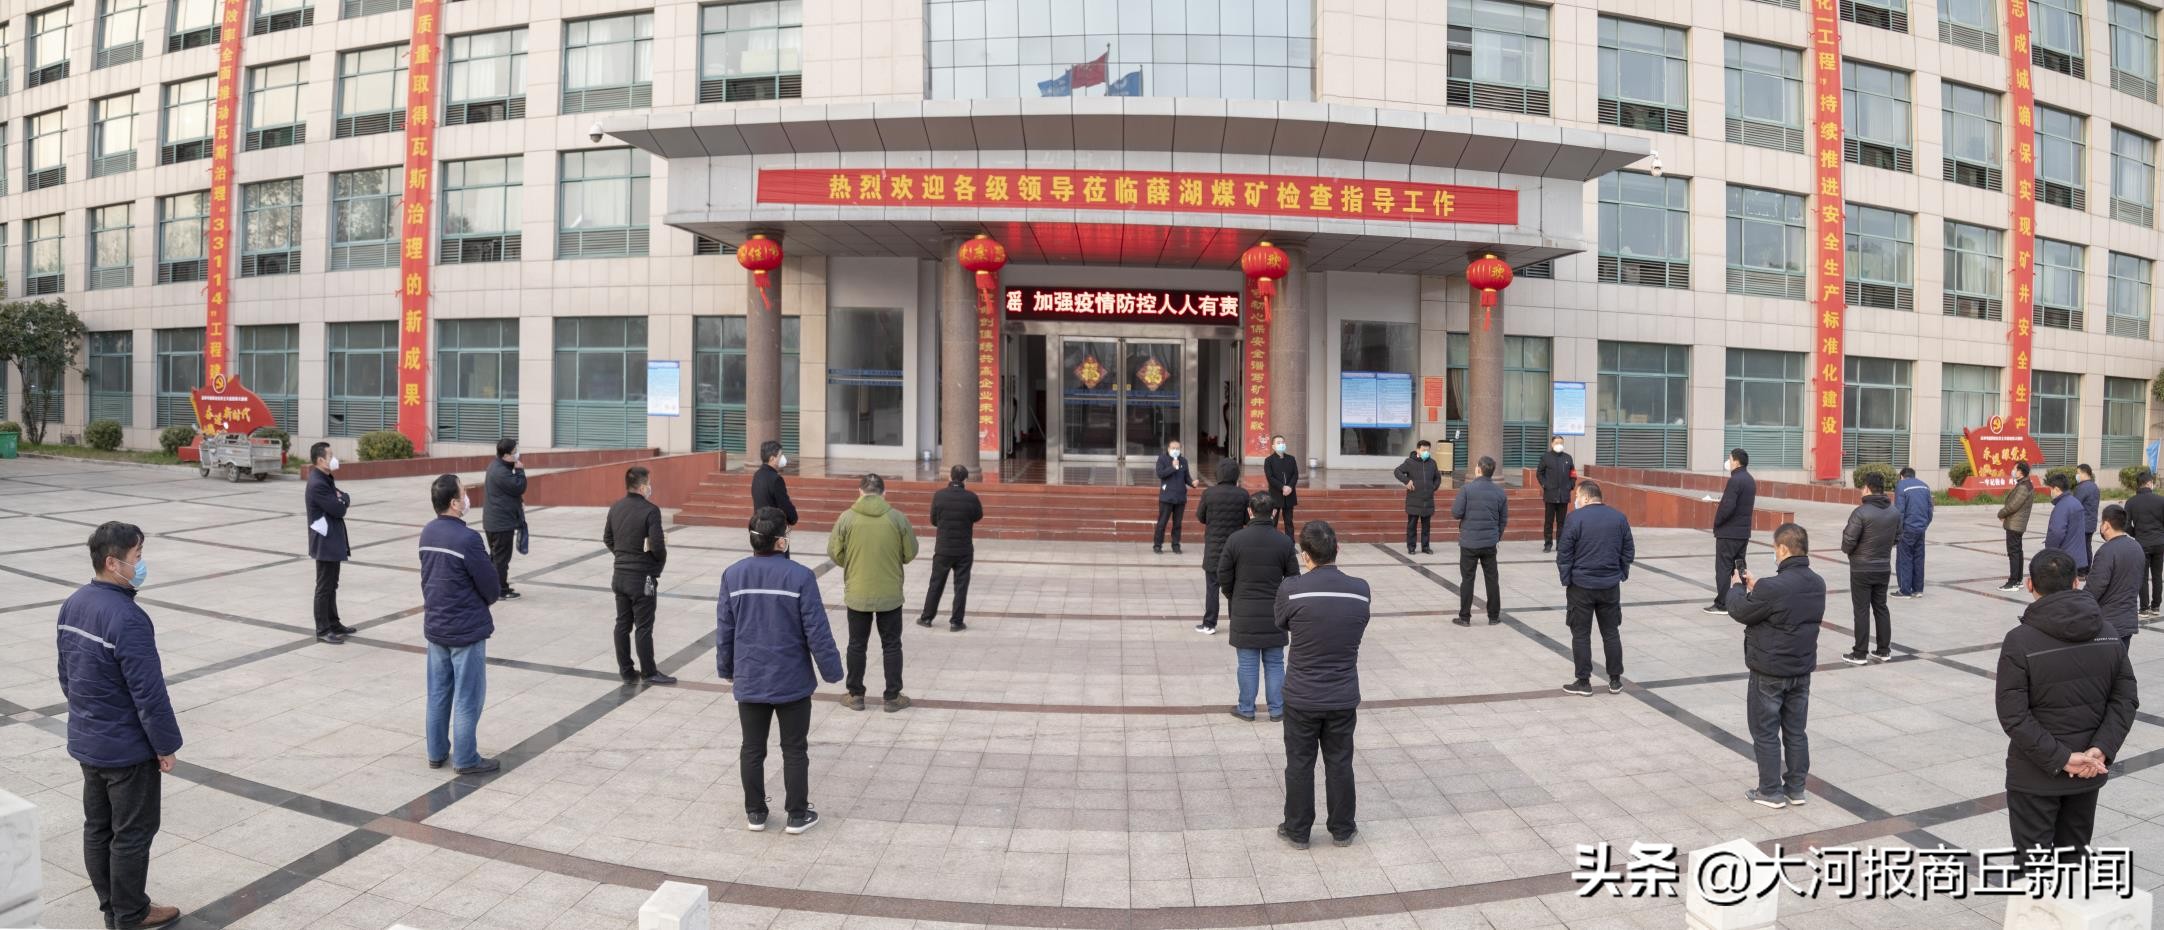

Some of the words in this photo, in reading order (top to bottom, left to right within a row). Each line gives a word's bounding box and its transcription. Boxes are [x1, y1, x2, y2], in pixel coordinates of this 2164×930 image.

[403, 0, 434, 407] 质量取得瓦斯治理的新成果
[828, 173, 1456, 217] 热烈欢迎各级领导莅临薛湖煤矿检查指导工作
[1033, 291, 1239, 317] 加强疫情防控人人有责
